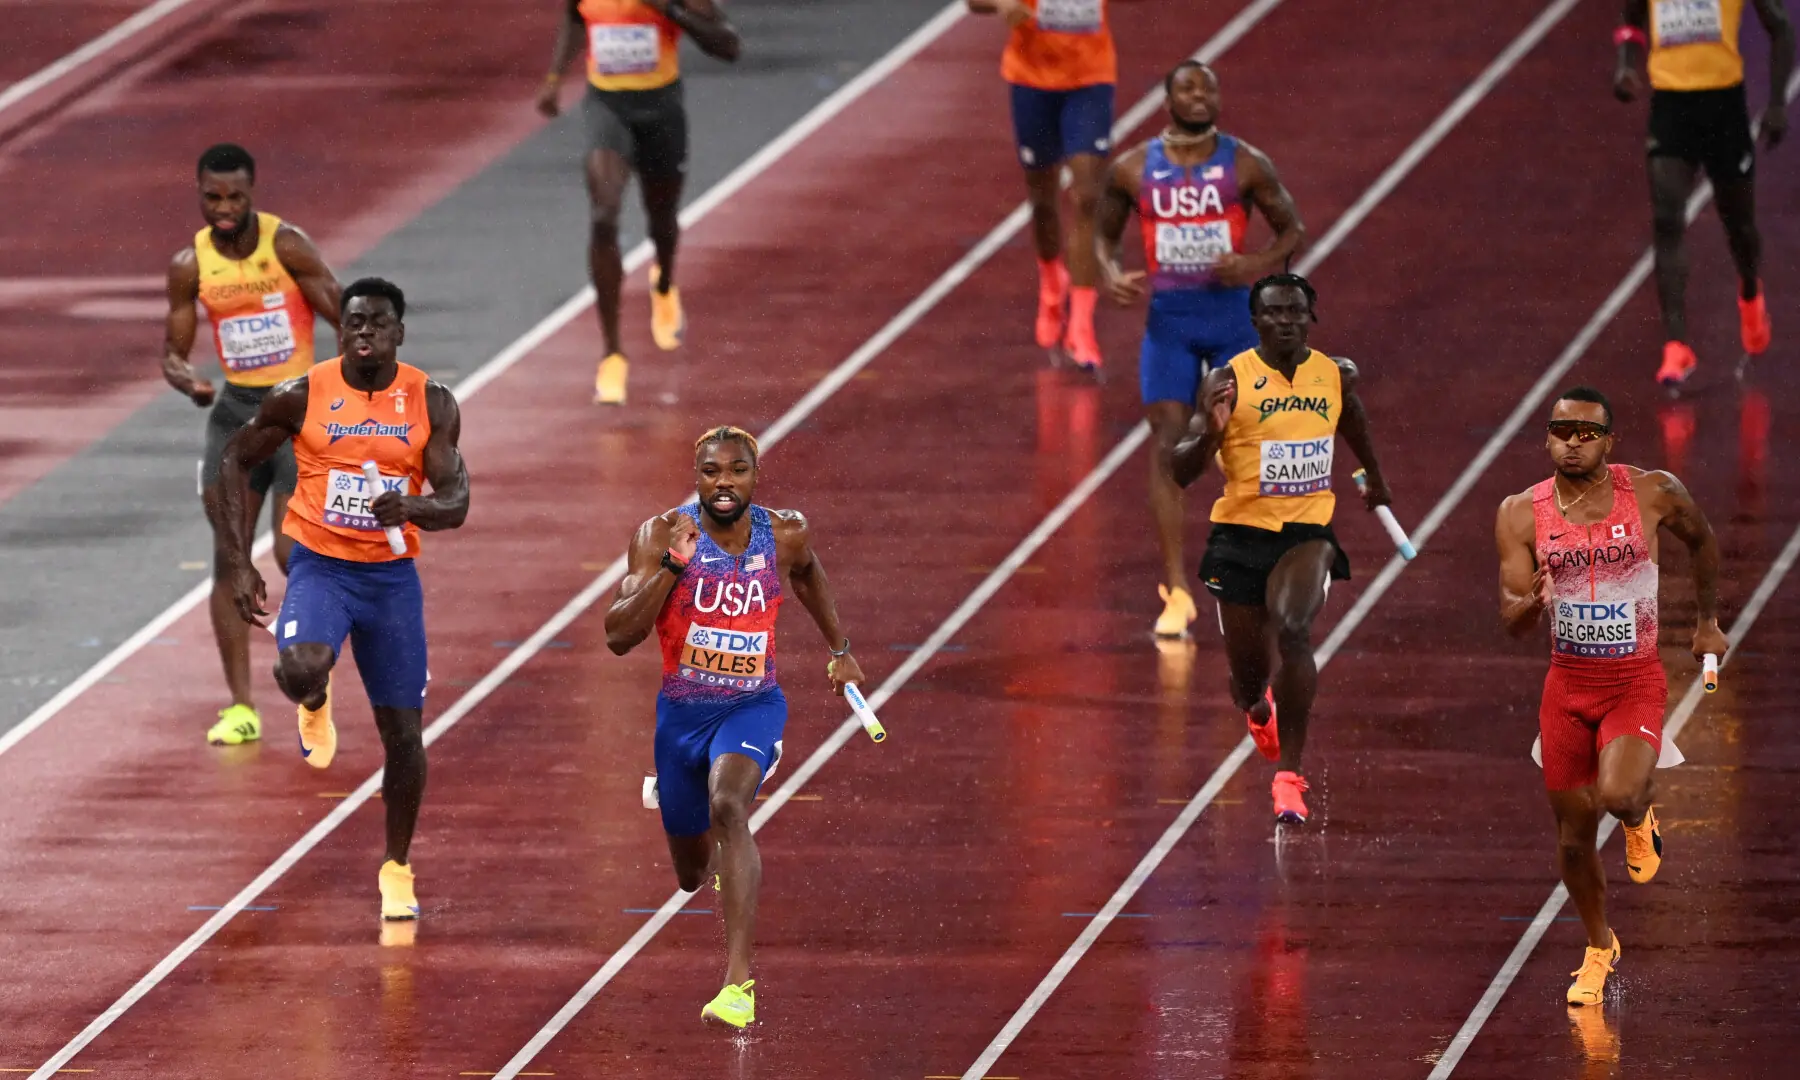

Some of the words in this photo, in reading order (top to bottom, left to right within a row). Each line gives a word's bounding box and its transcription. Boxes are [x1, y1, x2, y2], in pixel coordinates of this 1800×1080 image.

[1152, 184, 1224, 218] USA
[1180, 226, 1221, 240] TDK
[208, 278, 281, 300] GERMANY
[236, 314, 282, 333] TDK
[1260, 397, 1328, 413] GHANA
[327, 423, 408, 436] Nederland
[1284, 440, 1329, 458] TDK
[1265, 459, 1330, 480] SAMINU
[352, 476, 404, 493] TK
[1548, 544, 1635, 569] CANADA
[694, 578, 766, 617] USA
[1572, 603, 1629, 620] TDK
[711, 631, 763, 652] TDK
[1558, 621, 1574, 639] DE
[1576, 623, 1632, 642] GRASSE
[690, 649, 757, 674] LYLES
